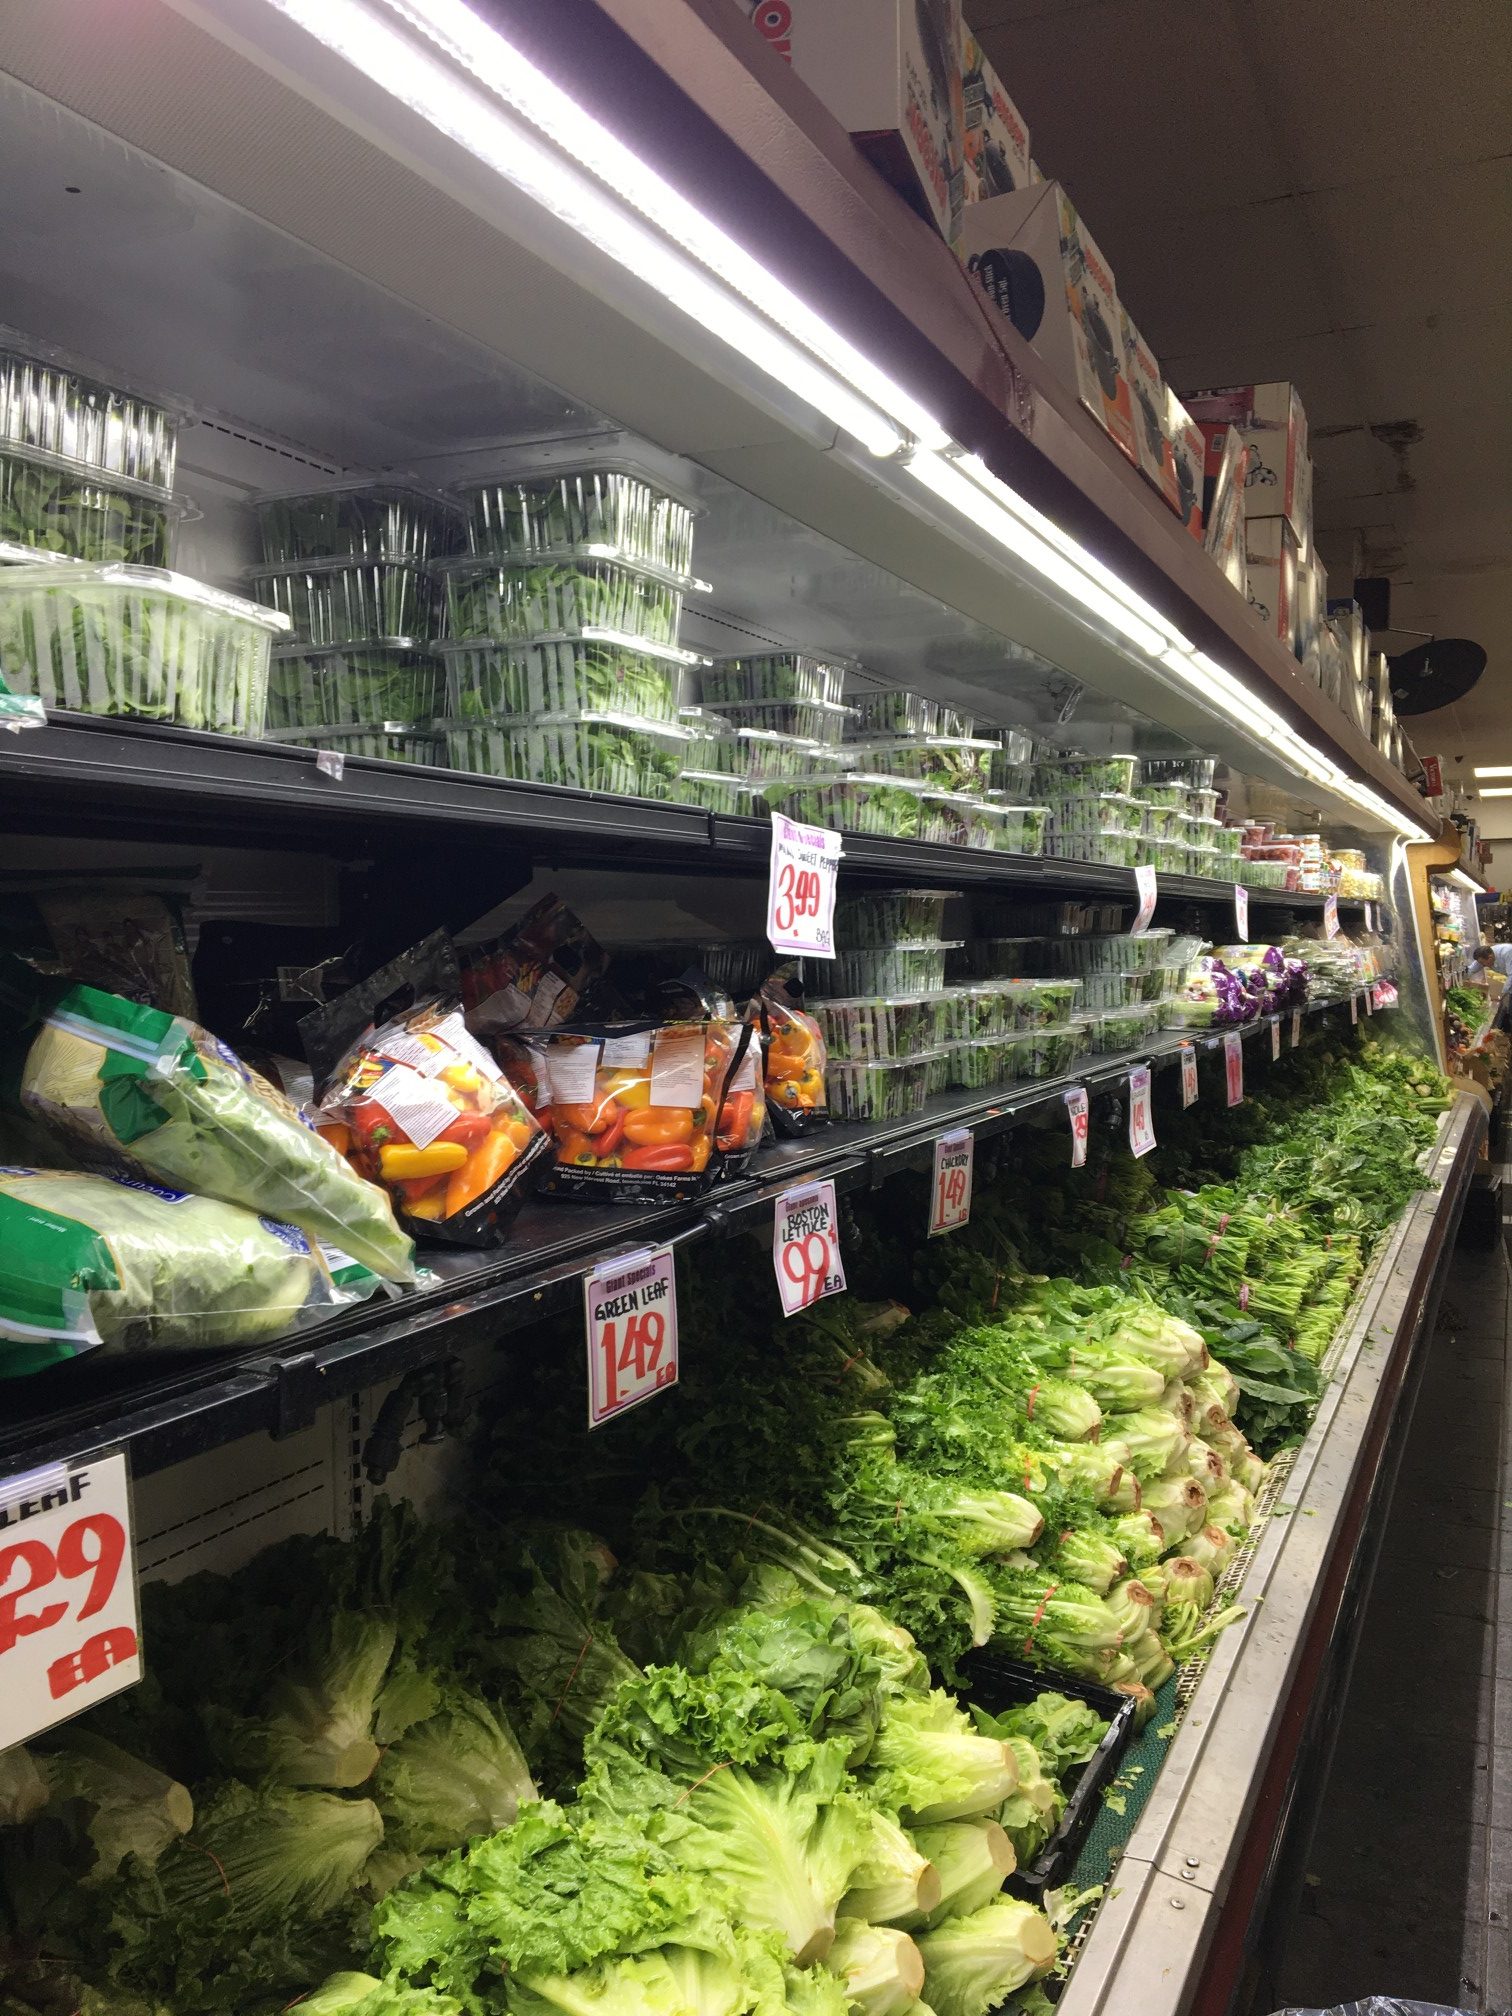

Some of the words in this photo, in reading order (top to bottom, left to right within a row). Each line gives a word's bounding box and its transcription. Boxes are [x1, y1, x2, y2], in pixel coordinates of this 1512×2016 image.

[787, 1202, 830, 1229] BOSTON
[782, 1217, 828, 1243] LETTUCE
[606, 1276, 626, 1294] Giant
[824, 1274, 843, 1291] EA
[594, 1290, 640, 1322] GREEN
[641, 1277, 670, 1306] LEAF
[46, 1626, 139, 1700] EA
